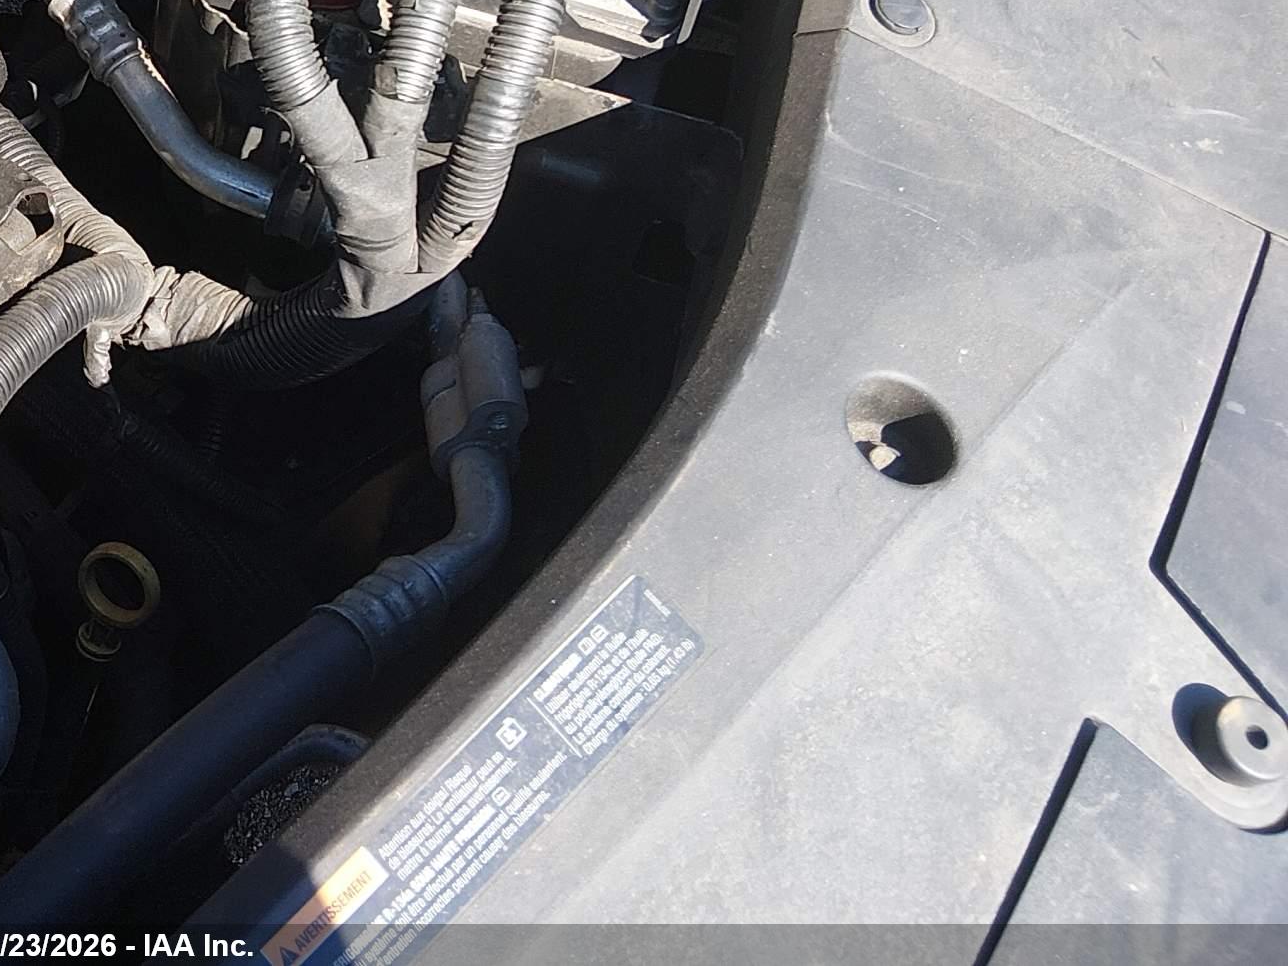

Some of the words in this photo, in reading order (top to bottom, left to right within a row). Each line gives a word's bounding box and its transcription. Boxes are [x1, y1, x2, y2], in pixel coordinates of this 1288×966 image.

[586, 661, 614, 691] R-134a
[616, 645, 630, 660] de
[603, 628, 627, 653] fluide
[580, 703, 613, 738] système
[608, 679, 636, 709] contient
[631, 669, 645, 684] du
[582, 726, 611, 757] Charge
[605, 717, 618, 732] du
[613, 690, 645, 723] système
[656, 662, 671, 679] kg
[377, 822, 413, 860] Attention
[409, 810, 426, 829] aux
[421, 785, 450, 816] doigts!
[444, 761, 473, 793] Risque
[386, 855, 401, 871] de
[441, 774, 480, 815] ventilateur
[475, 758, 496, 781] peut
[396, 852, 423, 881] mettre
[424, 819, 454, 851] tourner
[449, 803, 470, 825] sans
[362, 925, 398, 963] système
[405, 895, 426, 917] être
[421, 866, 454, 901] effectué
[450, 855, 467, 873] par
[462, 844, 476, 860] un
[472, 810, 510, 850] personnel
[503, 784, 534, 817] qualifié
[381, 885, 415, 921] R-134a
[428, 838, 460, 872] HAUTE
[450, 858, 483, 893] peuvent
[478, 835, 505, 864] causer
[500, 821, 518, 841] des
[293, 869, 372, 951] AVERTISSEMENT
